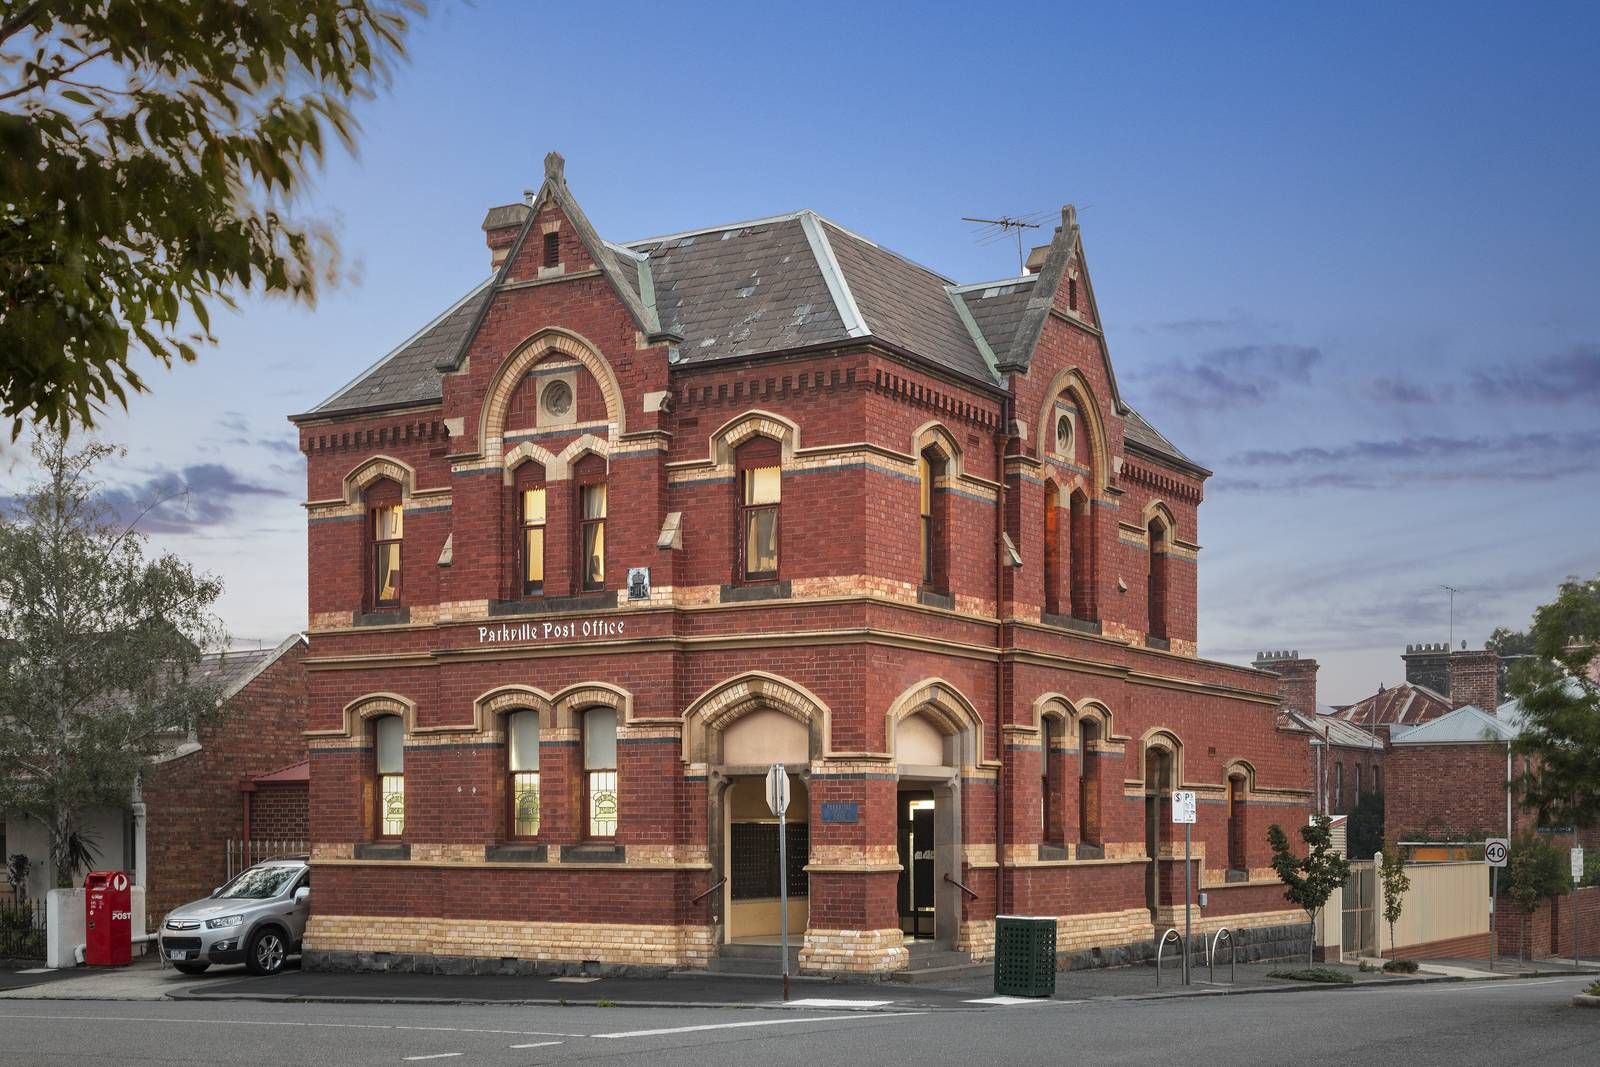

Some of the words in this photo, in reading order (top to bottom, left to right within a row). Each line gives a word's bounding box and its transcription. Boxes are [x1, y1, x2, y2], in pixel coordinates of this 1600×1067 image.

[478, 623, 538, 643] Parkville
[542, 622, 575, 639] Post
[582, 620, 625, 637] Office
[1487, 847, 1505, 858] 40
[112, 912, 132, 920] POST
